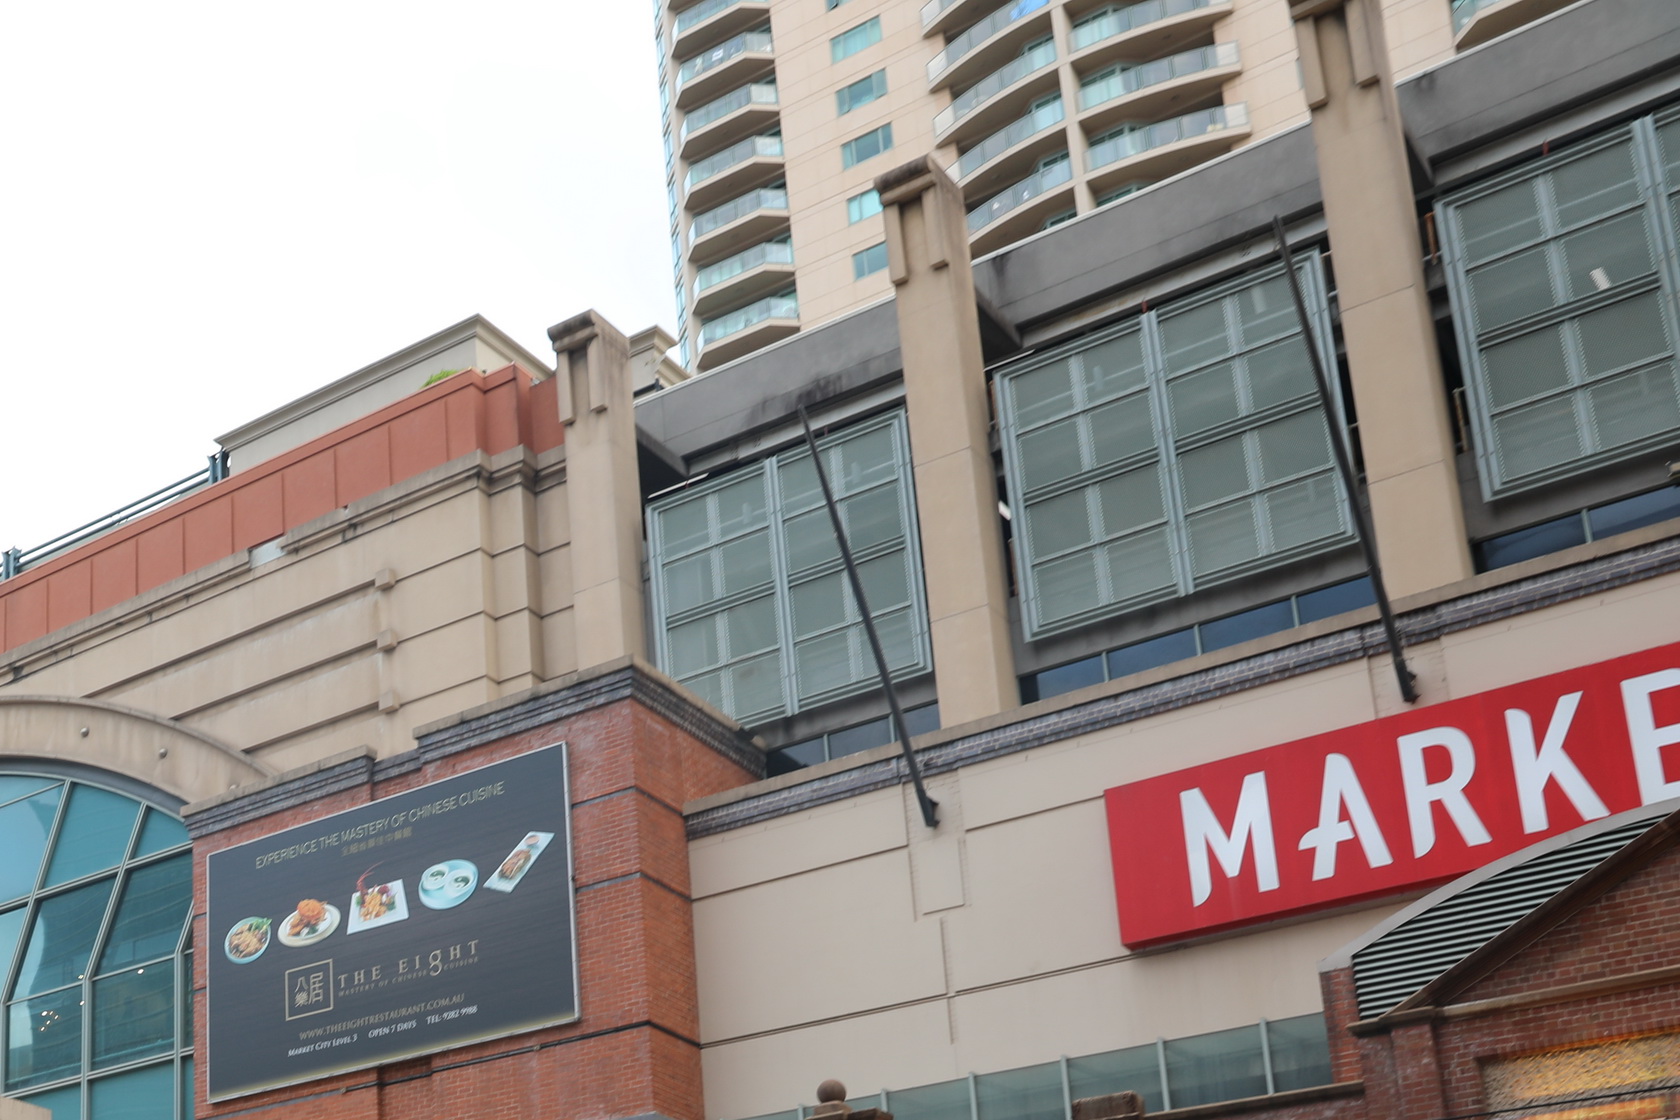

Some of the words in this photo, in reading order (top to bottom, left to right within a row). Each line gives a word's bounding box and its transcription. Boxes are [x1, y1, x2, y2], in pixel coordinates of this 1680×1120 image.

[255, 838, 319, 870] EXPERIENCE
[319, 831, 341, 850] THE
[340, 818, 390, 845] MASTERY
[391, 811, 408, 828] OF
[408, 798, 457, 823] CHINESE
[458, 780, 506, 807] CUISINE
[337, 965, 382, 989] THE
[368, 1025, 390, 1039] OPEN
[396, 1019, 417, 1032] DAYS
